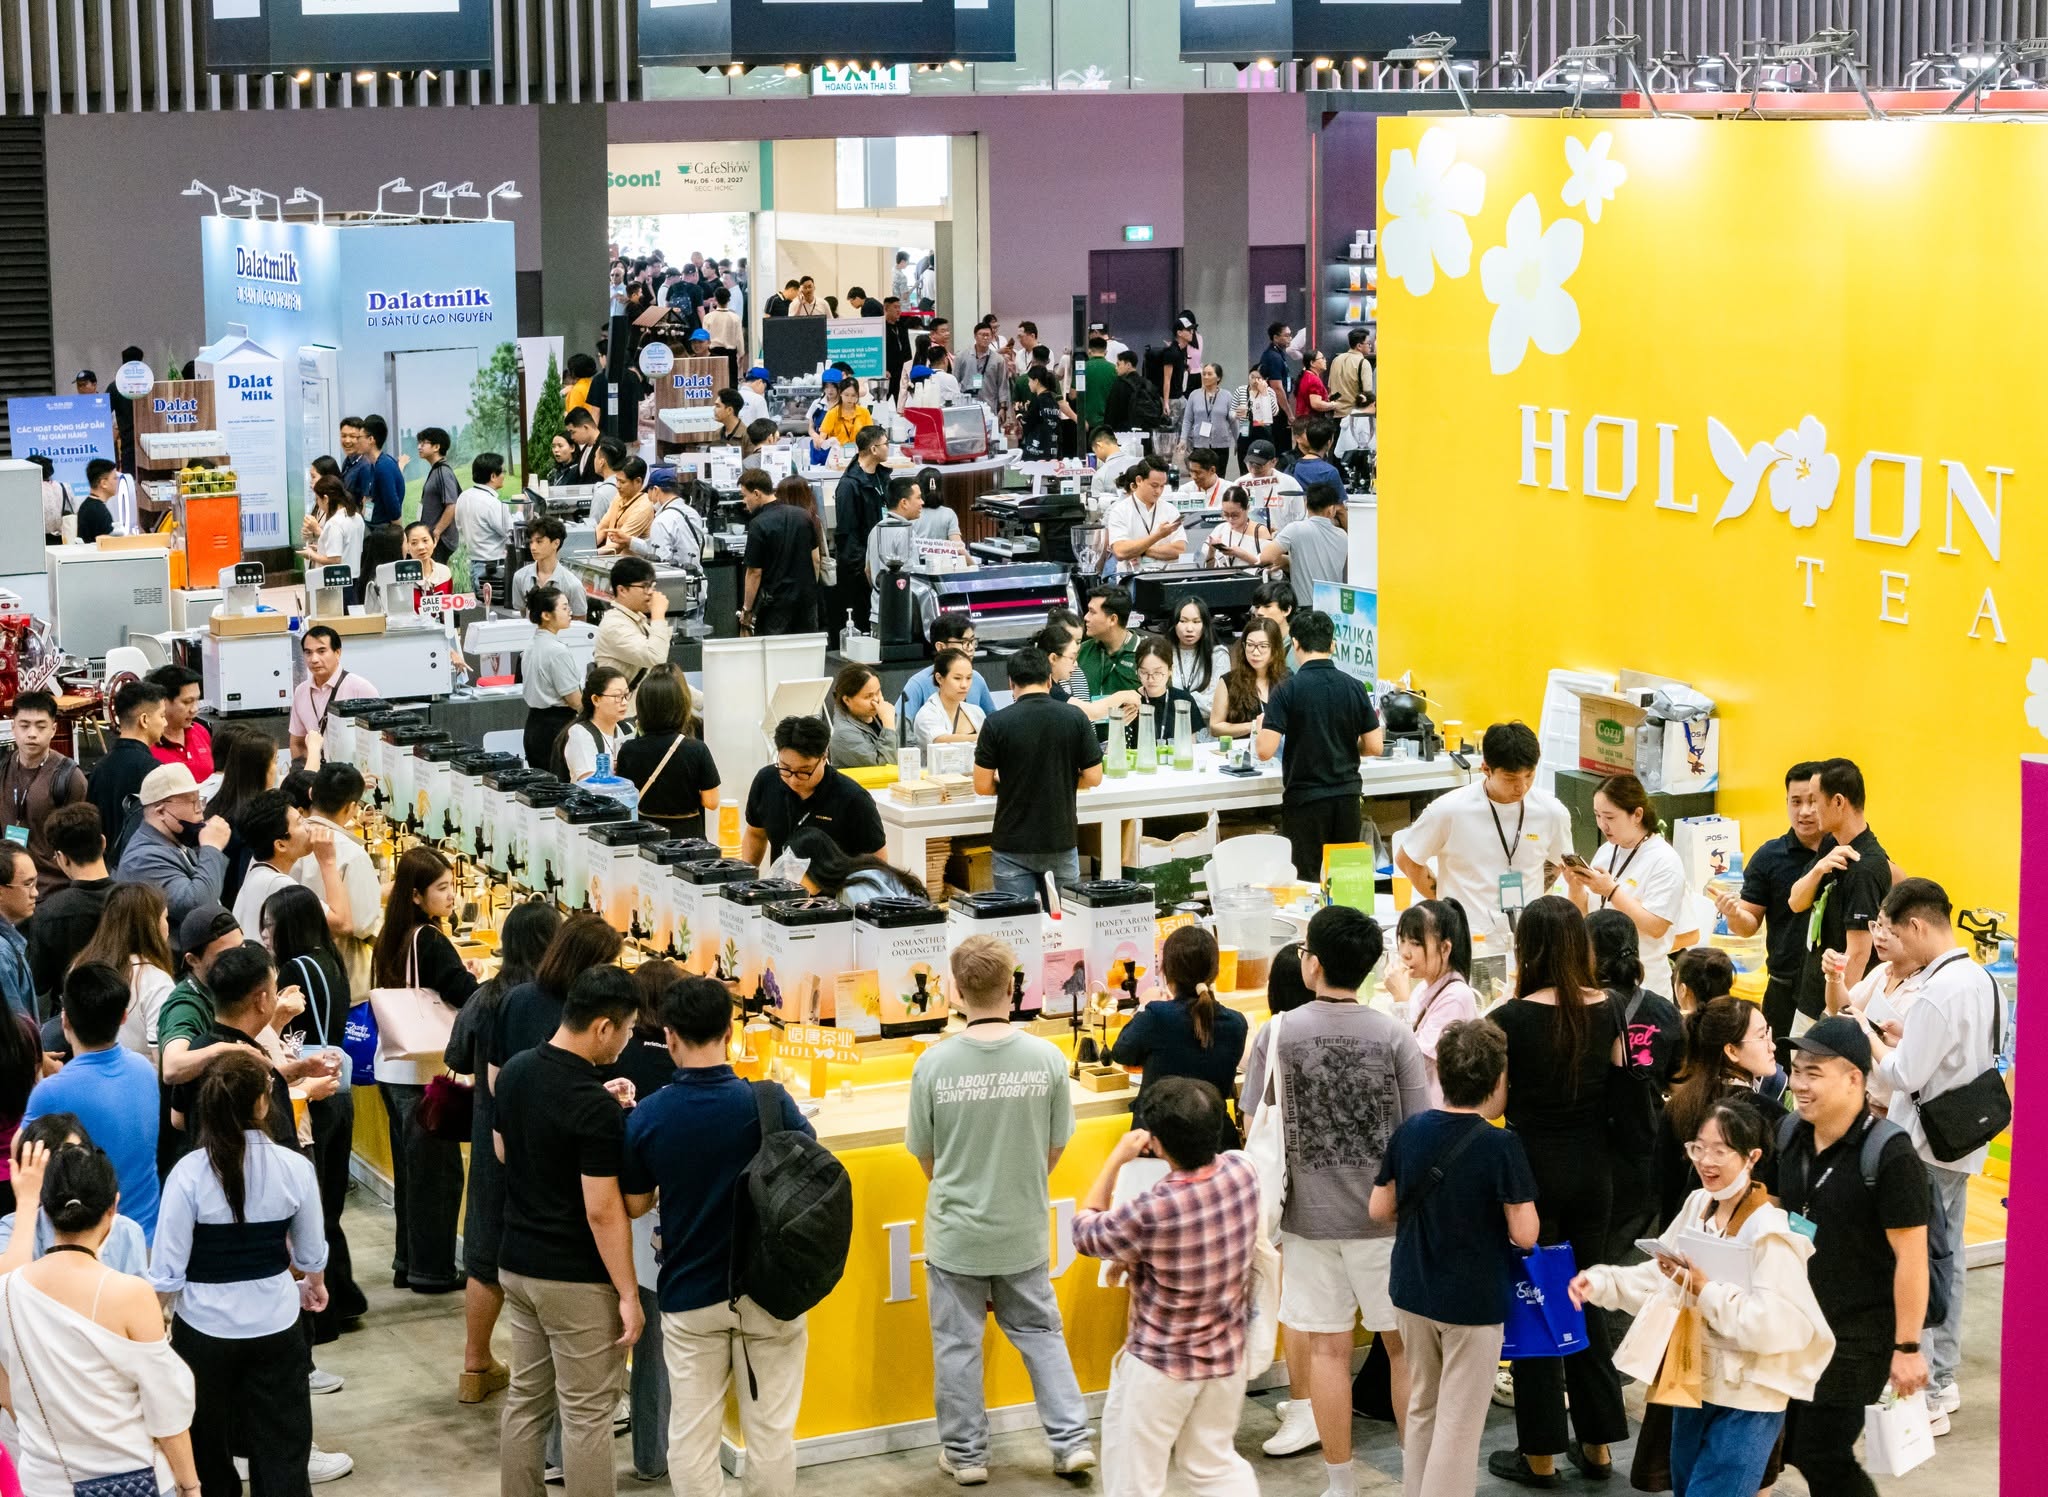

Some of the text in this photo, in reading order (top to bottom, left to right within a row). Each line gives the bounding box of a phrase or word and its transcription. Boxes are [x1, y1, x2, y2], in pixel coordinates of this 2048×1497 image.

[825, 83, 852, 91] HOANG
[870, 82, 887, 90] THAI
[694, 161, 750, 174] CafeShow
[236, 247, 298, 282] Dalatmilk
[264, 290, 277, 308] CAO
[368, 288, 490, 310] Dalatmilk
[368, 317, 378, 327] DI
[422, 314, 445, 325] CAO
[228, 374, 273, 389] Dalat
[674, 374, 713, 388] Dalat
[241, 391, 273, 401] Milk
[685, 389, 713, 399] Milk
[154, 398, 198, 413] Dalat
[166, 413, 198, 424] Milk
[29, 444, 99, 457] Dalatmilk
[1238, 477, 1280, 487] FAEMA
[921, 547, 956, 555] FAEMA
[422, 595, 476, 610] SALE 50%
[1795, 555, 2008, 644] TEA
[1334, 623, 1374, 647] AZUKA
[1354, 644, 1375, 668] ĐÀ
[1597, 722, 1623, 744] Cozy
[1095, 918, 1123, 929] HONEY
[991, 928, 1024, 938] CEYLON
[1104, 925, 1148, 937] BLACK TEA
[892, 935, 946, 948] OSMANTHUS
[1015, 938, 1031, 946] TEA
[891, 944, 947, 957] OOLONG TEA
[935, 1070, 1049, 1091] ALL ABOUT BALANCE
[936, 1084, 1049, 1105] ALL ABOUT BALANCE
